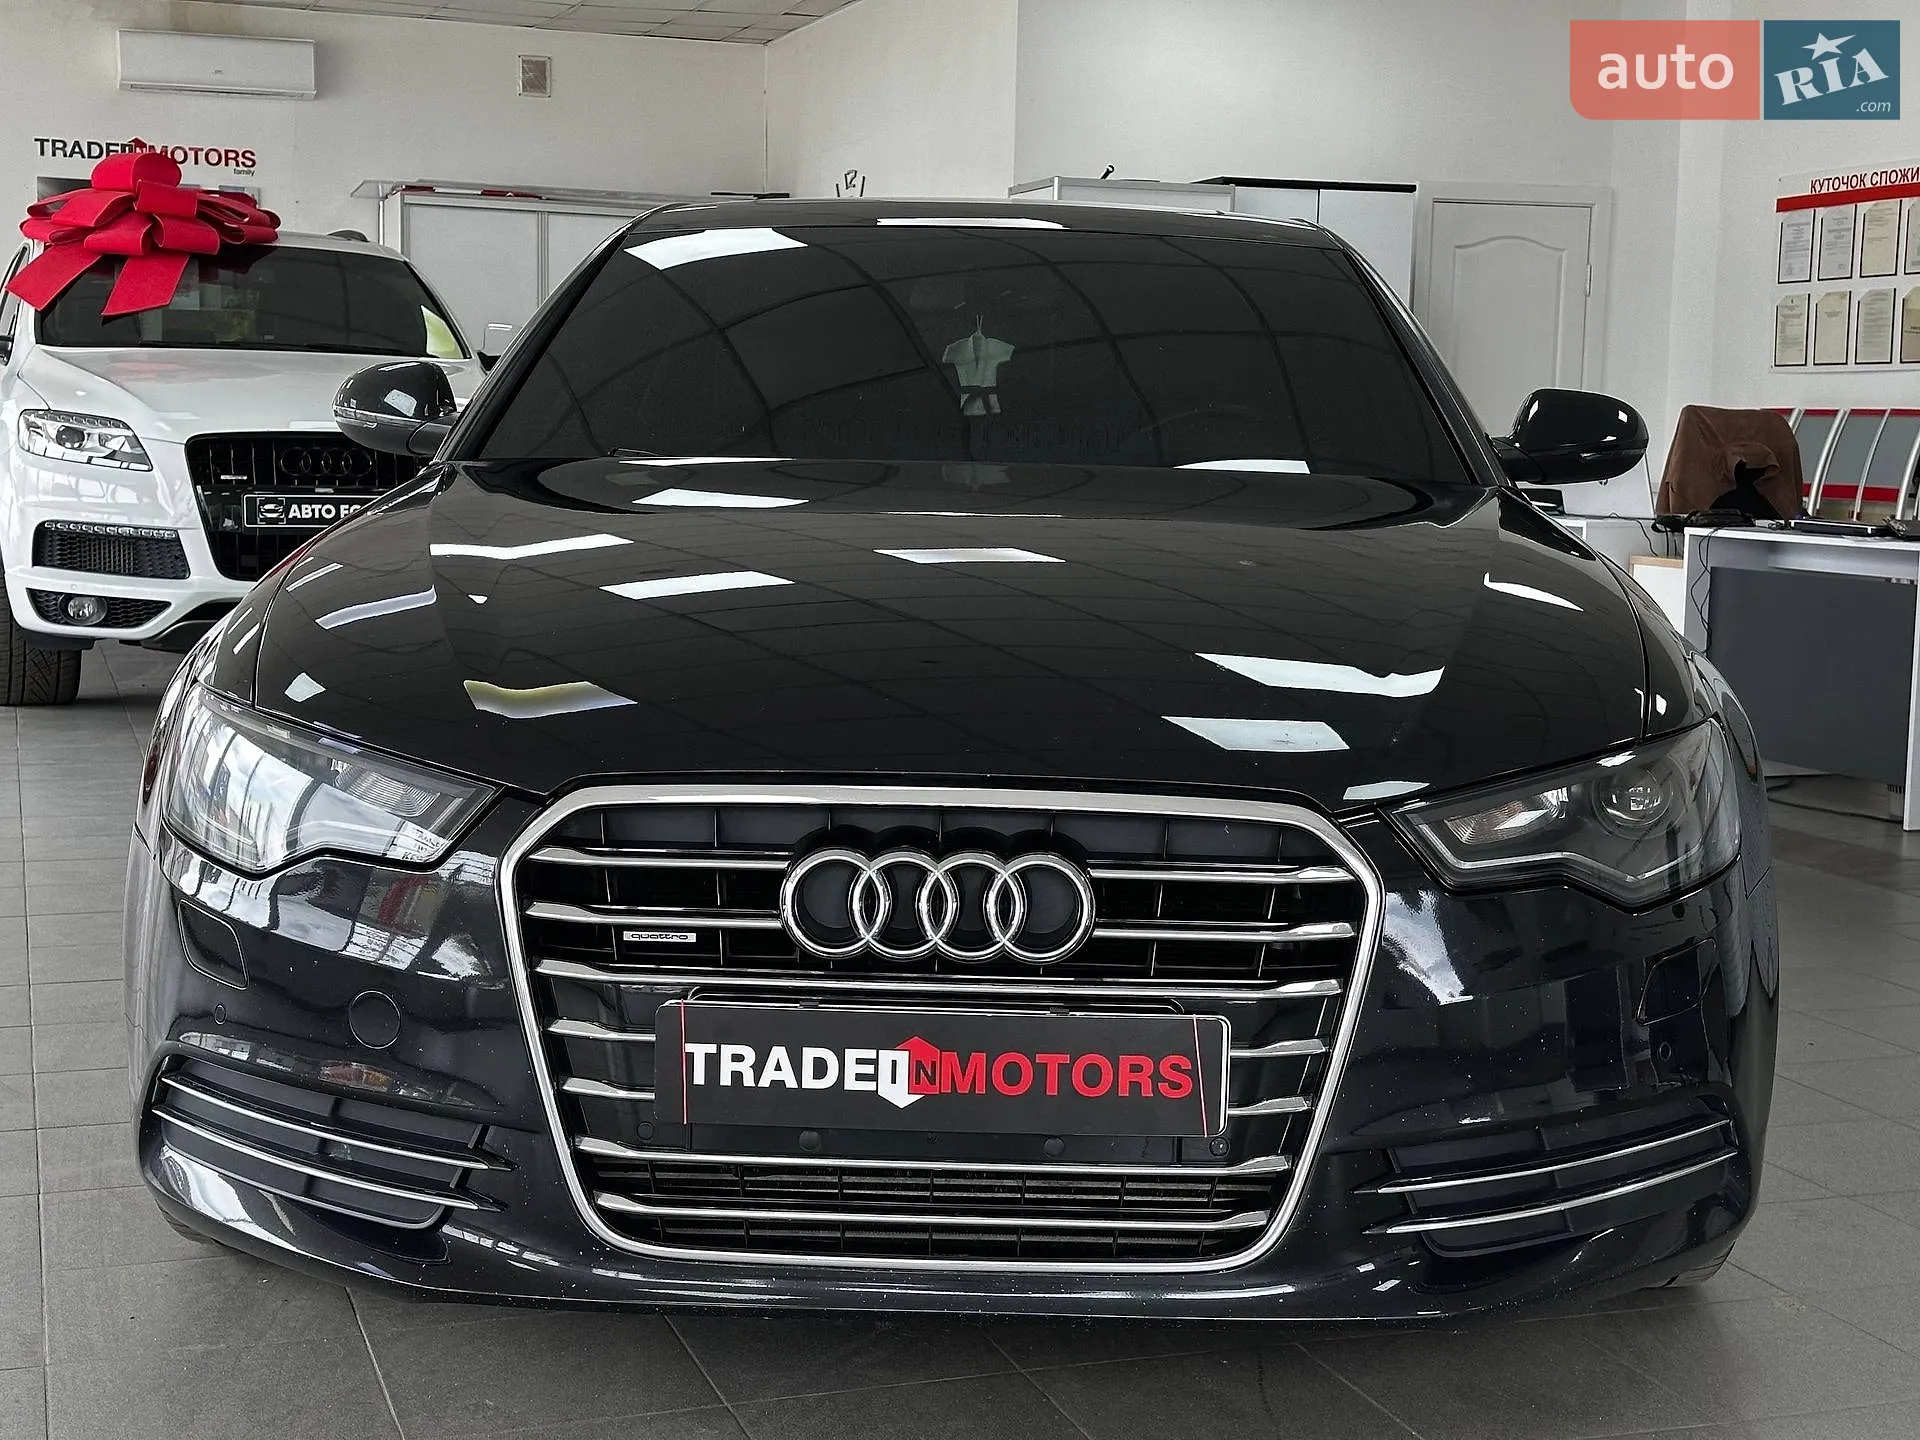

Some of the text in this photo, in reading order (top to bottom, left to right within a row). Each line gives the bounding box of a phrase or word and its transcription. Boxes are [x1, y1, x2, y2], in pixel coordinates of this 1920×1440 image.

[1810, 167, 1920, 194] КУТОЧОК СПОЖИ
[288, 504, 336, 519] АВТО
[630, 933, 689, 941] quattro
[684, 1042, 878, 1091] TRADE
[940, 1051, 1193, 1098] MOTORS
